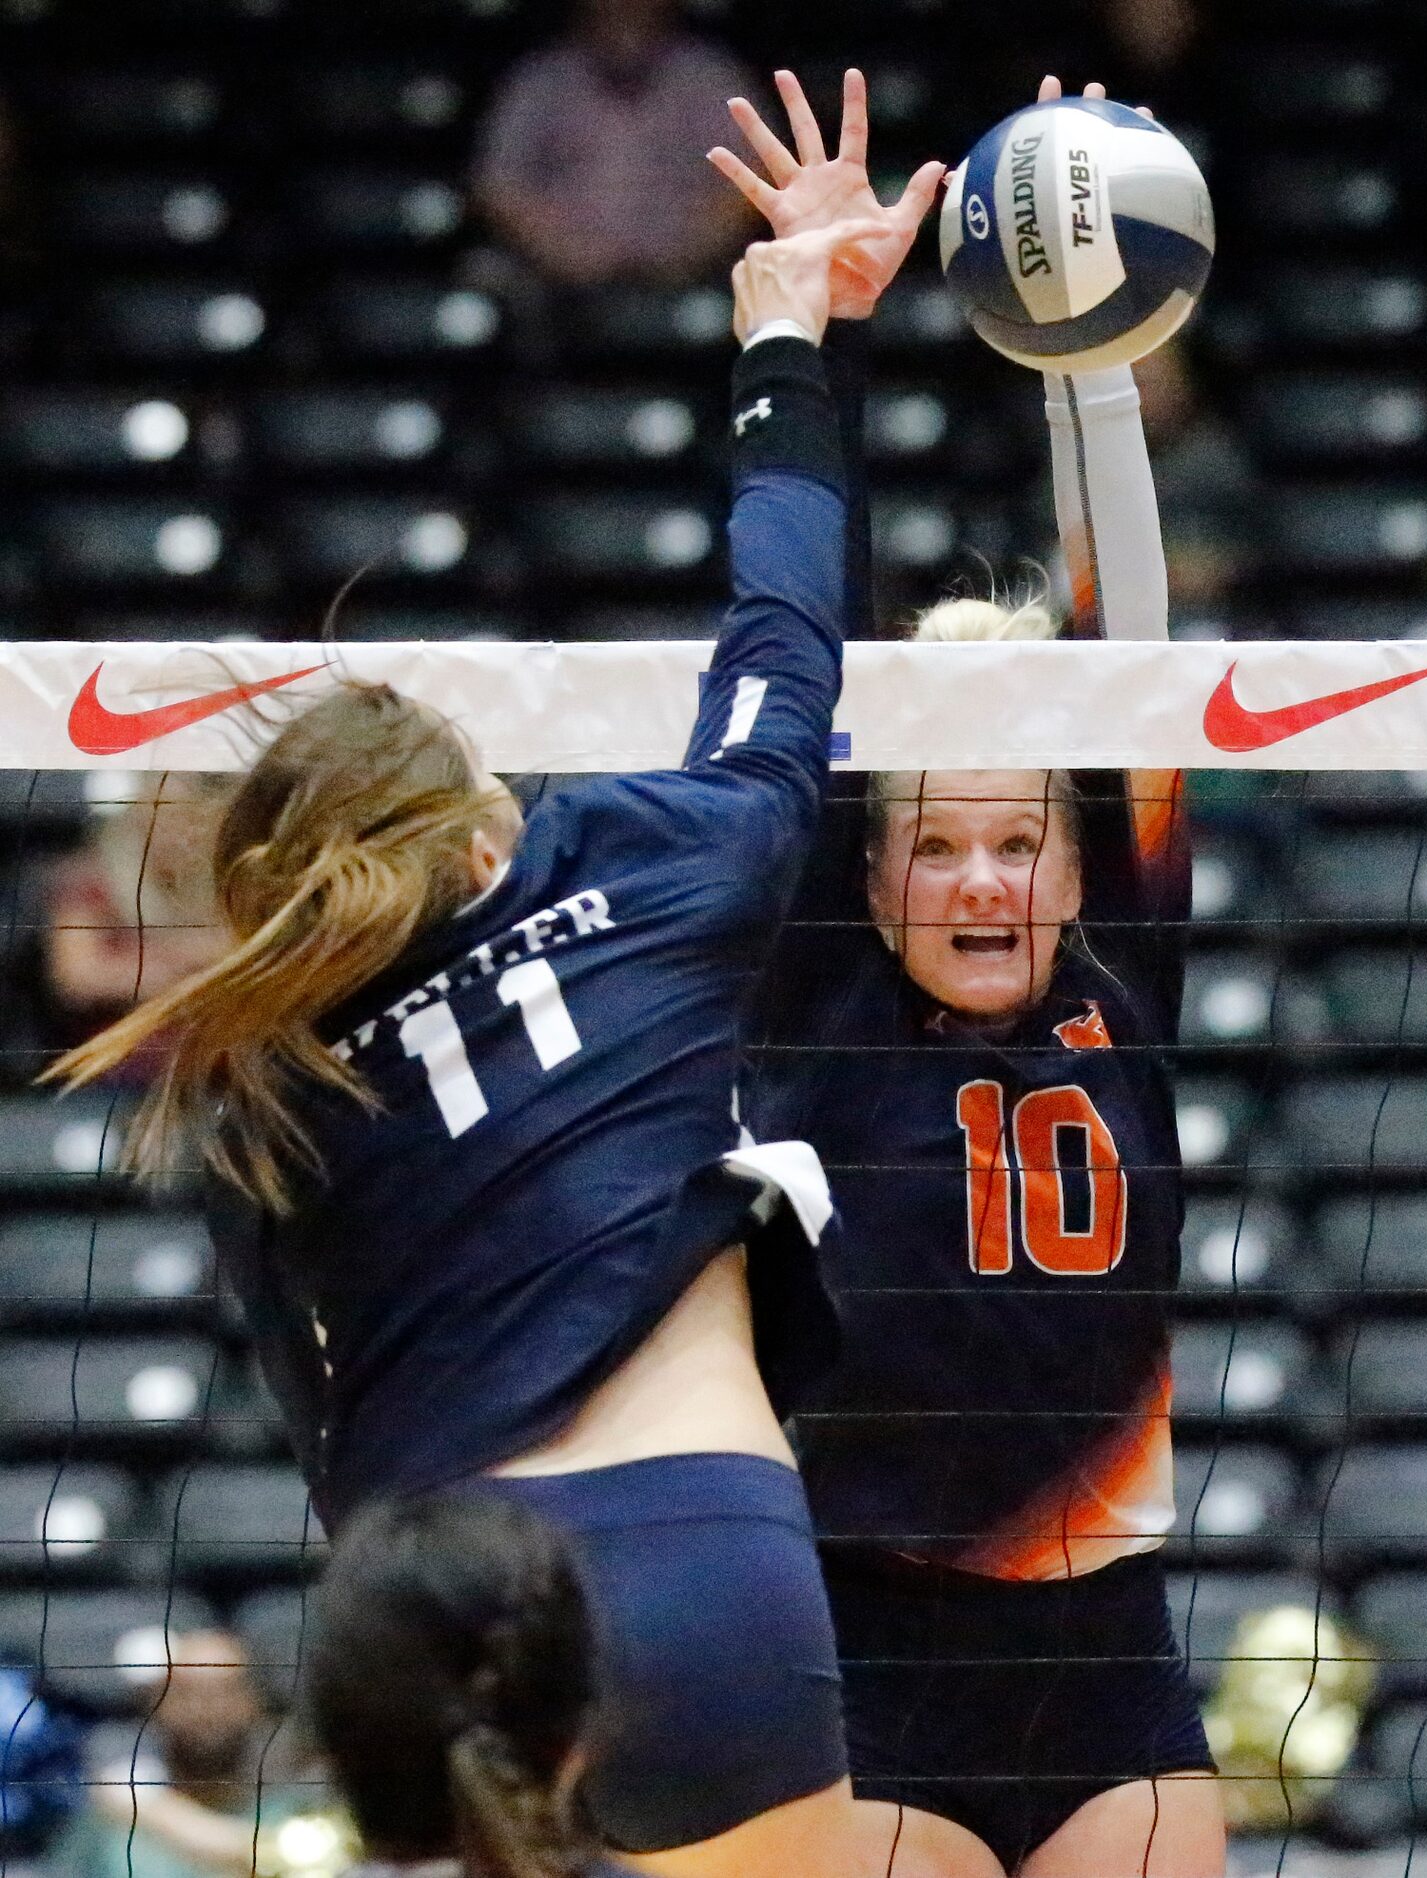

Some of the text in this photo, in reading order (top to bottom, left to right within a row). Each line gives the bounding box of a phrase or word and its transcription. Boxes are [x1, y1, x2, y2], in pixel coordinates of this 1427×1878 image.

[1011, 131, 1052, 279] SPALDING
[1068, 149, 1094, 248] TF-VB5
[399, 957, 583, 1140] 11
[956, 1078, 1129, 1276] 10
